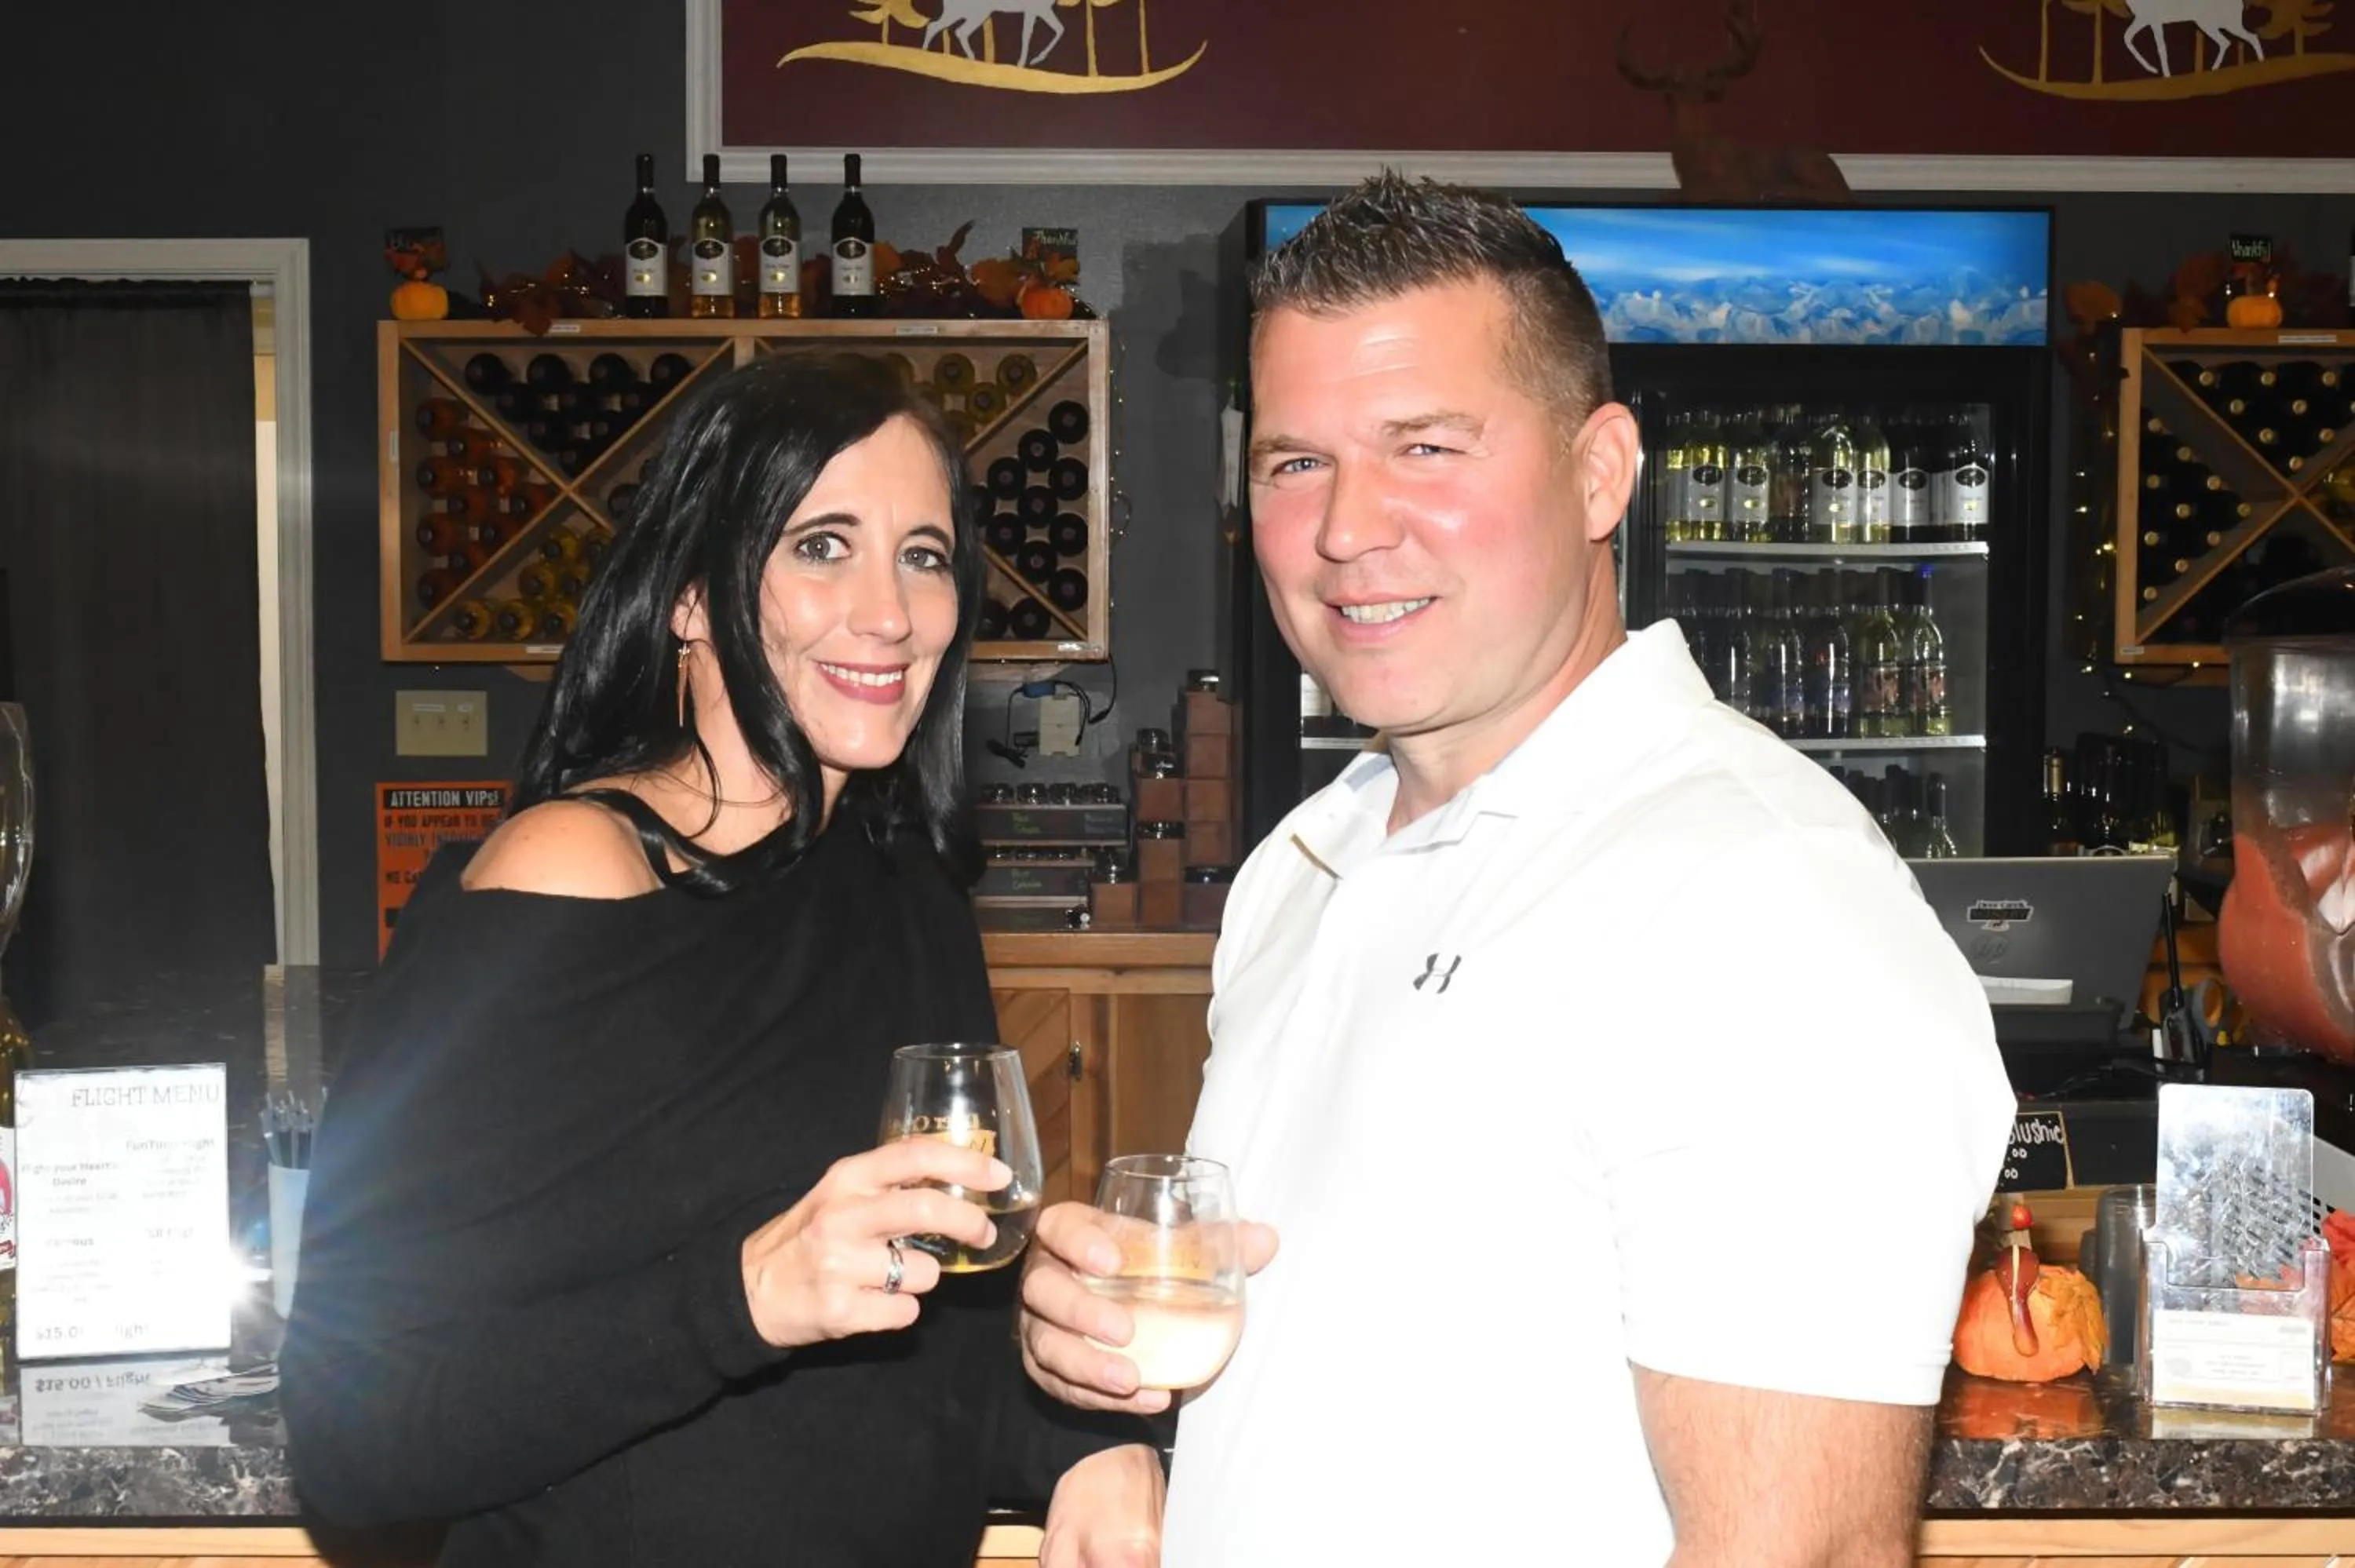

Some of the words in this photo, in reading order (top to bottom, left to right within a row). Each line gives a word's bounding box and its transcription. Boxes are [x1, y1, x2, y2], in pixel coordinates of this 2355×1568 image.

[390, 790, 460, 808] ATTENTION
[70, 1085, 148, 1108] FLIGHT
[153, 1083, 221, 1105] MENU
